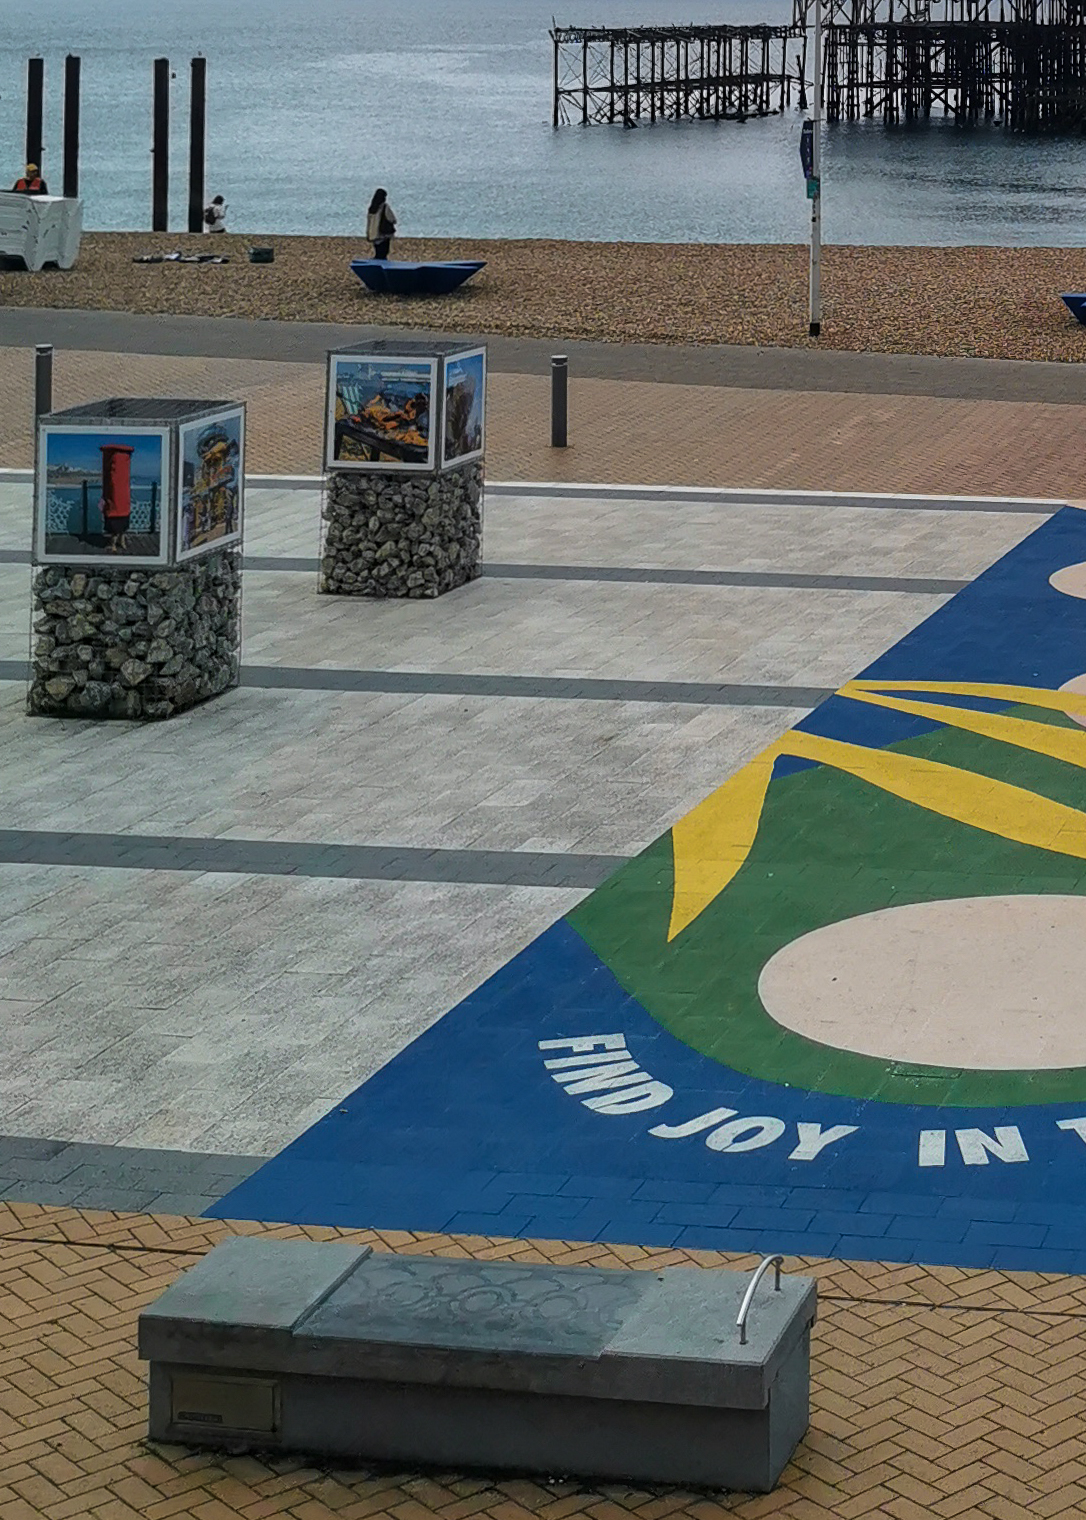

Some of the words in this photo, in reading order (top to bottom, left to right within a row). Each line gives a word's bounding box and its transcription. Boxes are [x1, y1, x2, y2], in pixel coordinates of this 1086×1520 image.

[538, 1033, 674, 1115] FIND
[647, 1107, 859, 1161] JOY
[918, 1125, 1030, 1167] IN
